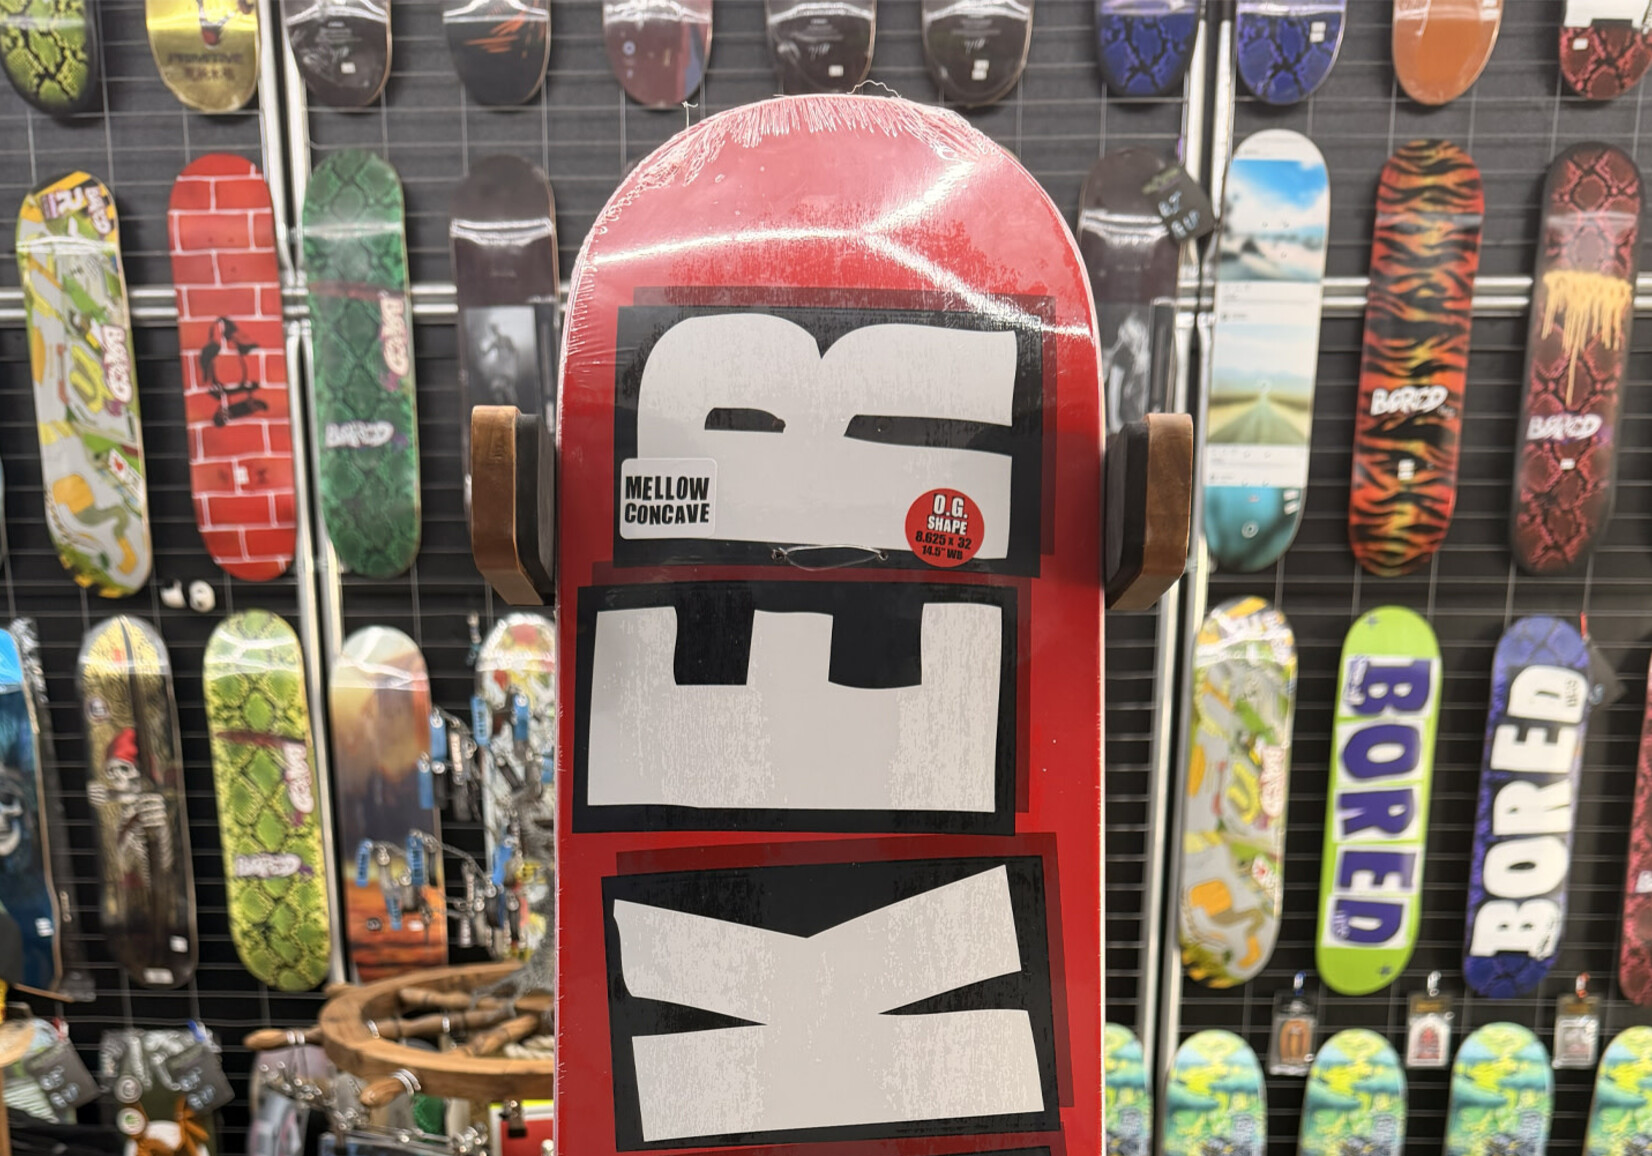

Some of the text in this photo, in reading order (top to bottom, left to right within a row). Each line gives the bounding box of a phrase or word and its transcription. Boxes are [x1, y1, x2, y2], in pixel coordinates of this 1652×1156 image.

[625, 475, 710, 501] MELLOW
[624, 502, 710, 526] CONCAVE
[933, 493, 969, 519] O.G.
[927, 515, 968, 536] SHAPE
[914, 530, 947, 547] 8.625
[956, 537, 972, 550] 32
[1335, 658, 1434, 946] BORED
[1470, 664, 1589, 958] BORED
